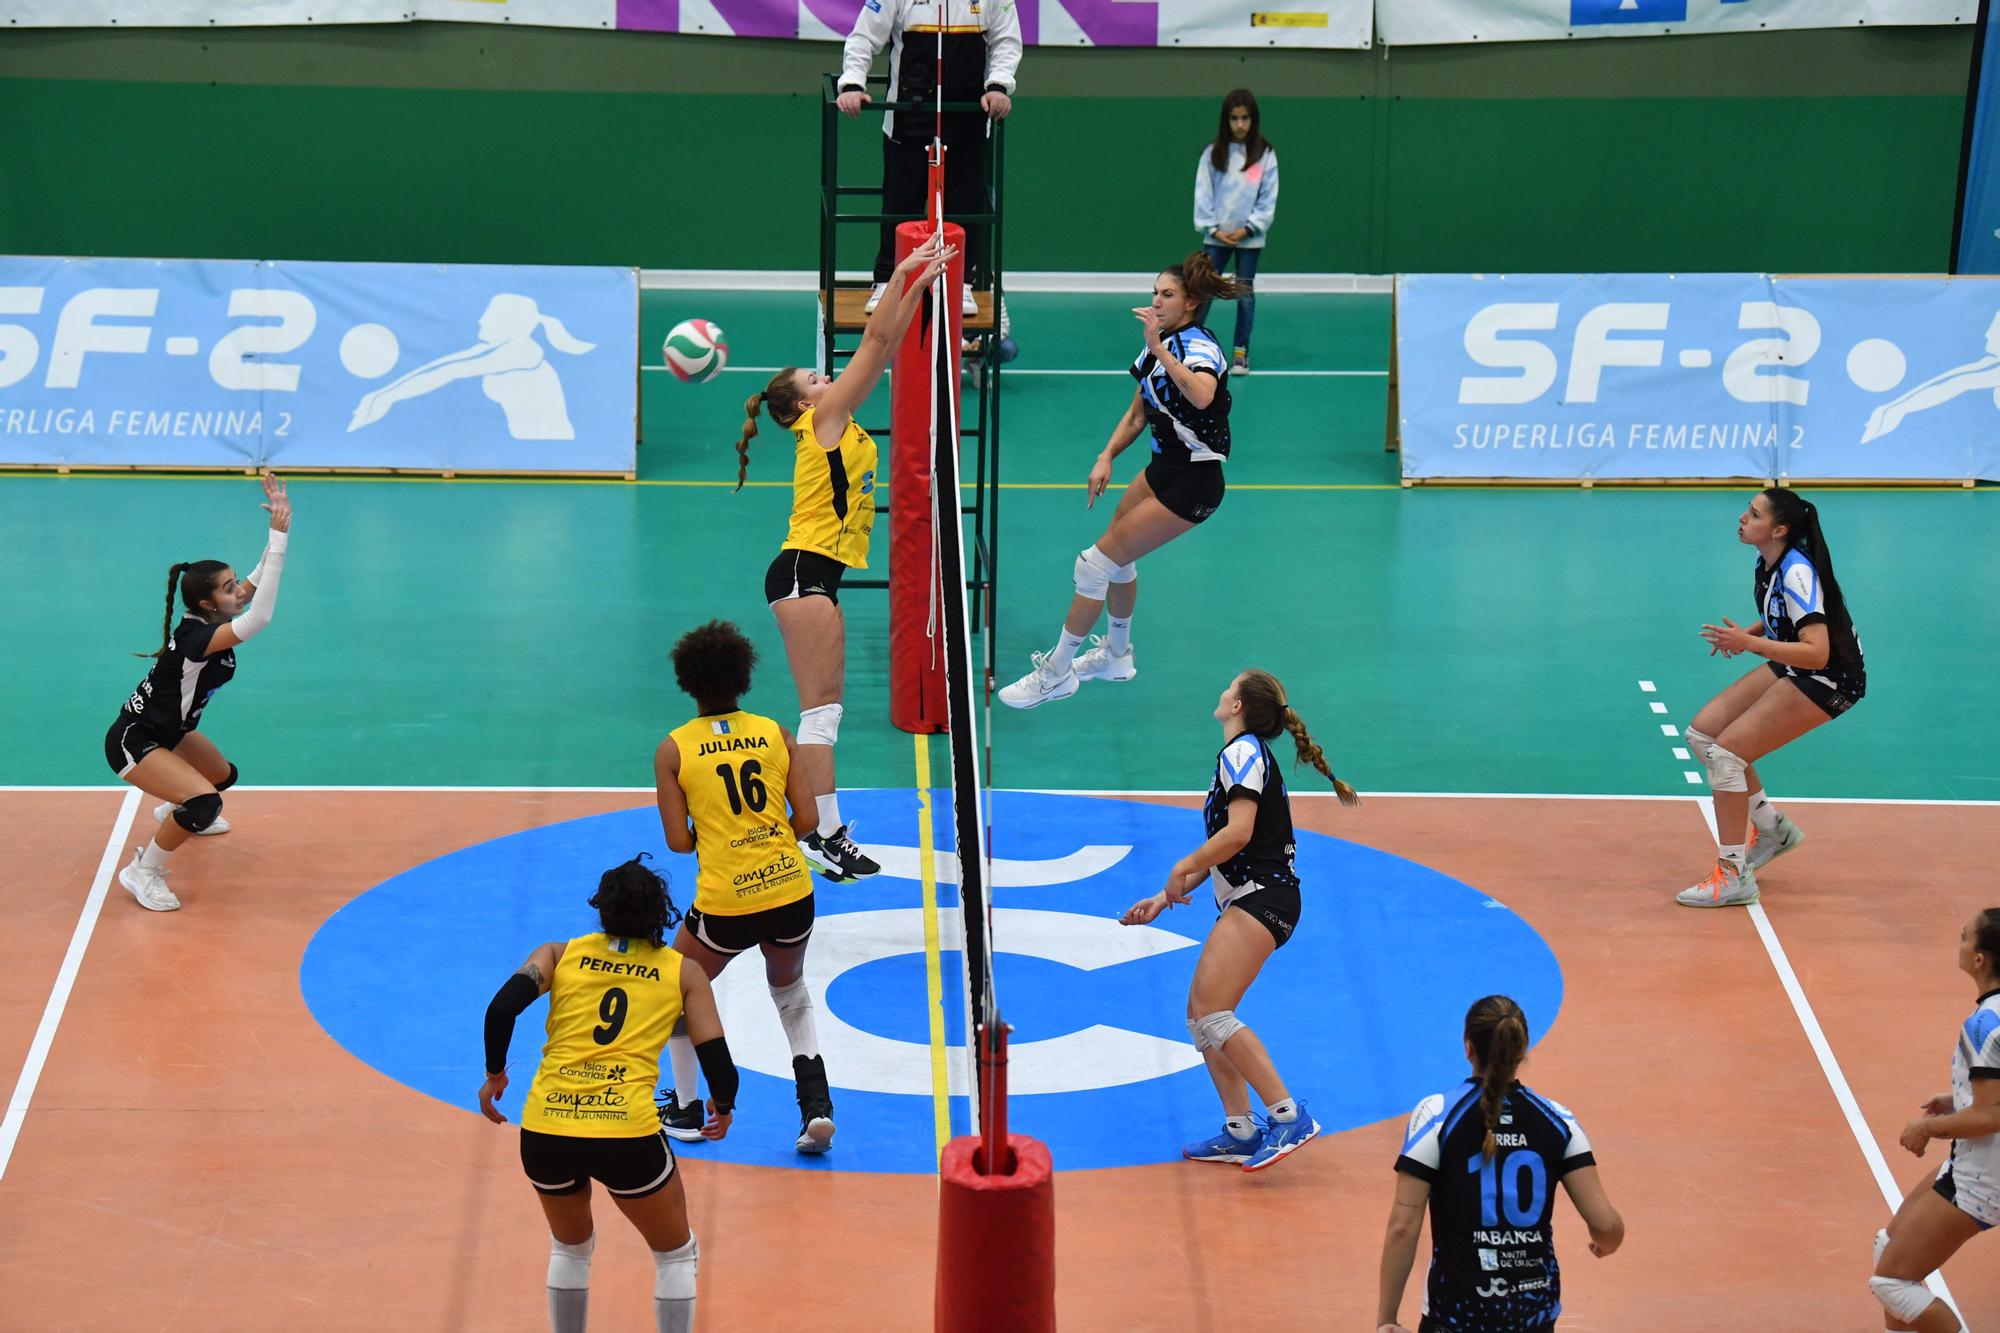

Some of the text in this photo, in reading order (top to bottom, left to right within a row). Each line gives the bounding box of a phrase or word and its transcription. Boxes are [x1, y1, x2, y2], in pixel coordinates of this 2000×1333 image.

[1458, 302, 1821, 406] SF-2
[108, 410, 263, 436] FEMENINA
[274, 412, 293, 437] 2
[1453, 423, 1805, 449] SUPERLIGA FEMENINA 2
[698, 736, 769, 756] JULIANA
[716, 759, 767, 815] 16
[730, 832, 769, 848] Canarias
[747, 825, 767, 836] Islas
[579, 956, 660, 981] PEREYRA
[593, 987, 628, 1046] 9
[559, 1066, 606, 1080] Canarias
[584, 1061, 607, 1072] Islas
[543, 1110, 572, 1119] STYLE
[582, 1112, 628, 1121] RUNNING
[1467, 1149, 1546, 1227] 10
